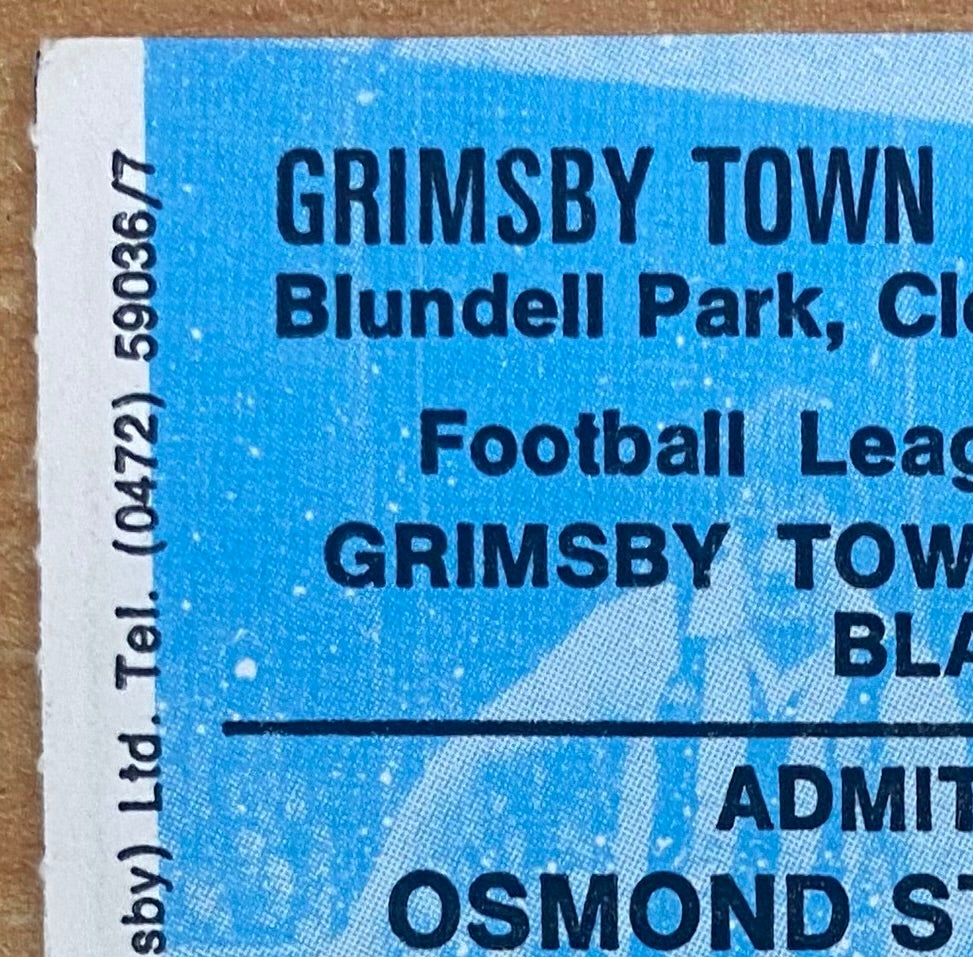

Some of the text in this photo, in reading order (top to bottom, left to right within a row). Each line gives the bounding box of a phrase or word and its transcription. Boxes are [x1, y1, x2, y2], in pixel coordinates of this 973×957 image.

[277, 147, 653, 244] GRIMSBY
[692, 147, 933, 244] TOWN
[112, 150, 161, 361] 59036/7
[277, 273, 603, 338] Blundell
[639, 273, 843, 351] Park,
[112, 393, 165, 555] (0472)
[421, 410, 744, 475] Football
[325, 522, 729, 589] GRIMSBY
[115, 592, 160, 689] Tel.
[118, 715, 162, 811] Ltd.
[389, 870, 849, 951] OSMOND
